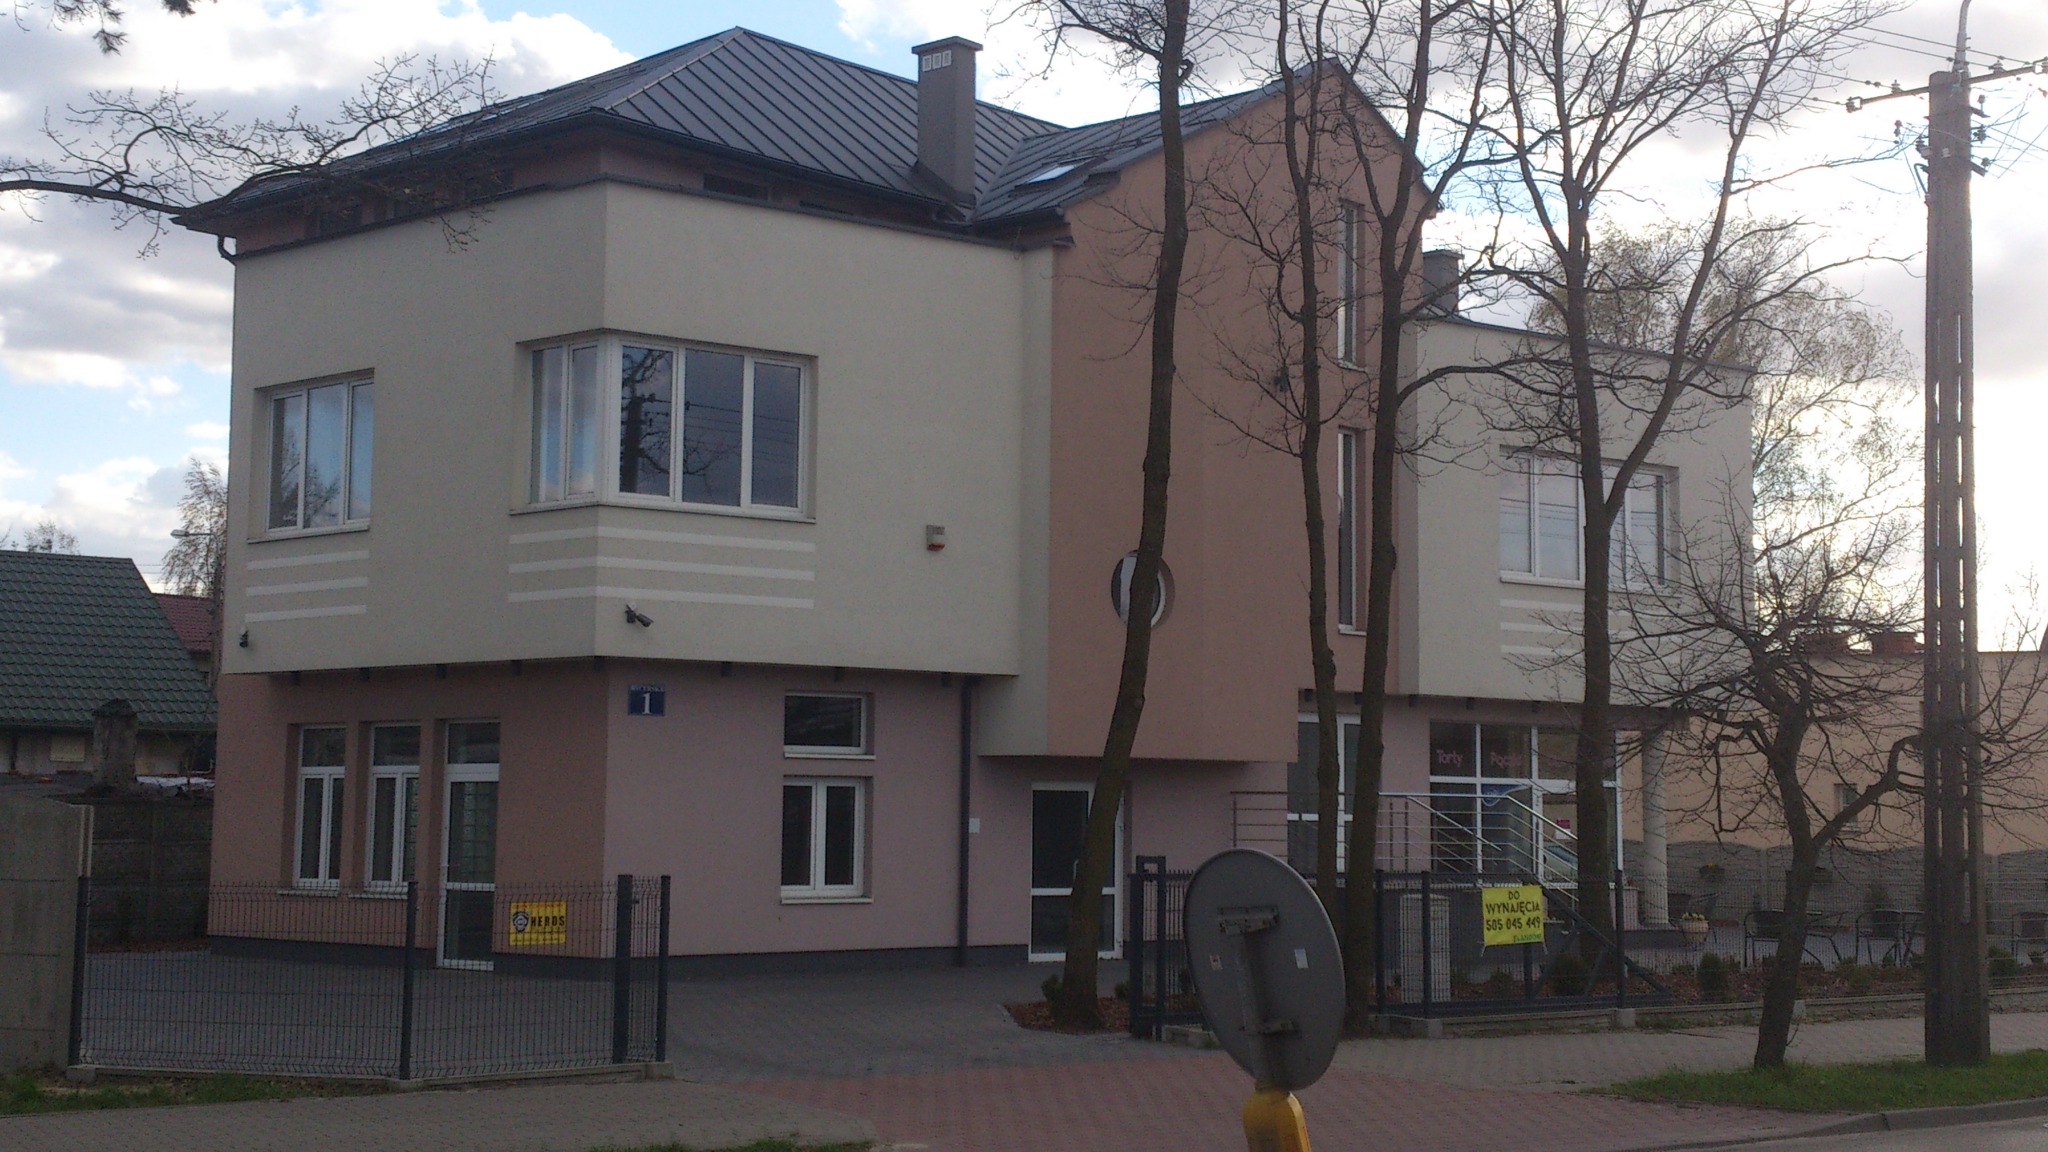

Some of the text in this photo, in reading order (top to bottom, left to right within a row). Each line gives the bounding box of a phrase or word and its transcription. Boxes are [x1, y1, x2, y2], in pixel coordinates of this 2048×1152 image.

[642, 692, 652, 715] 1
[1508, 890, 1520, 900] DO
[1485, 901, 1541, 915] WYNAJĘCIA
[1486, 919, 1503, 931] 505
[1506, 918, 1523, 930] 045
